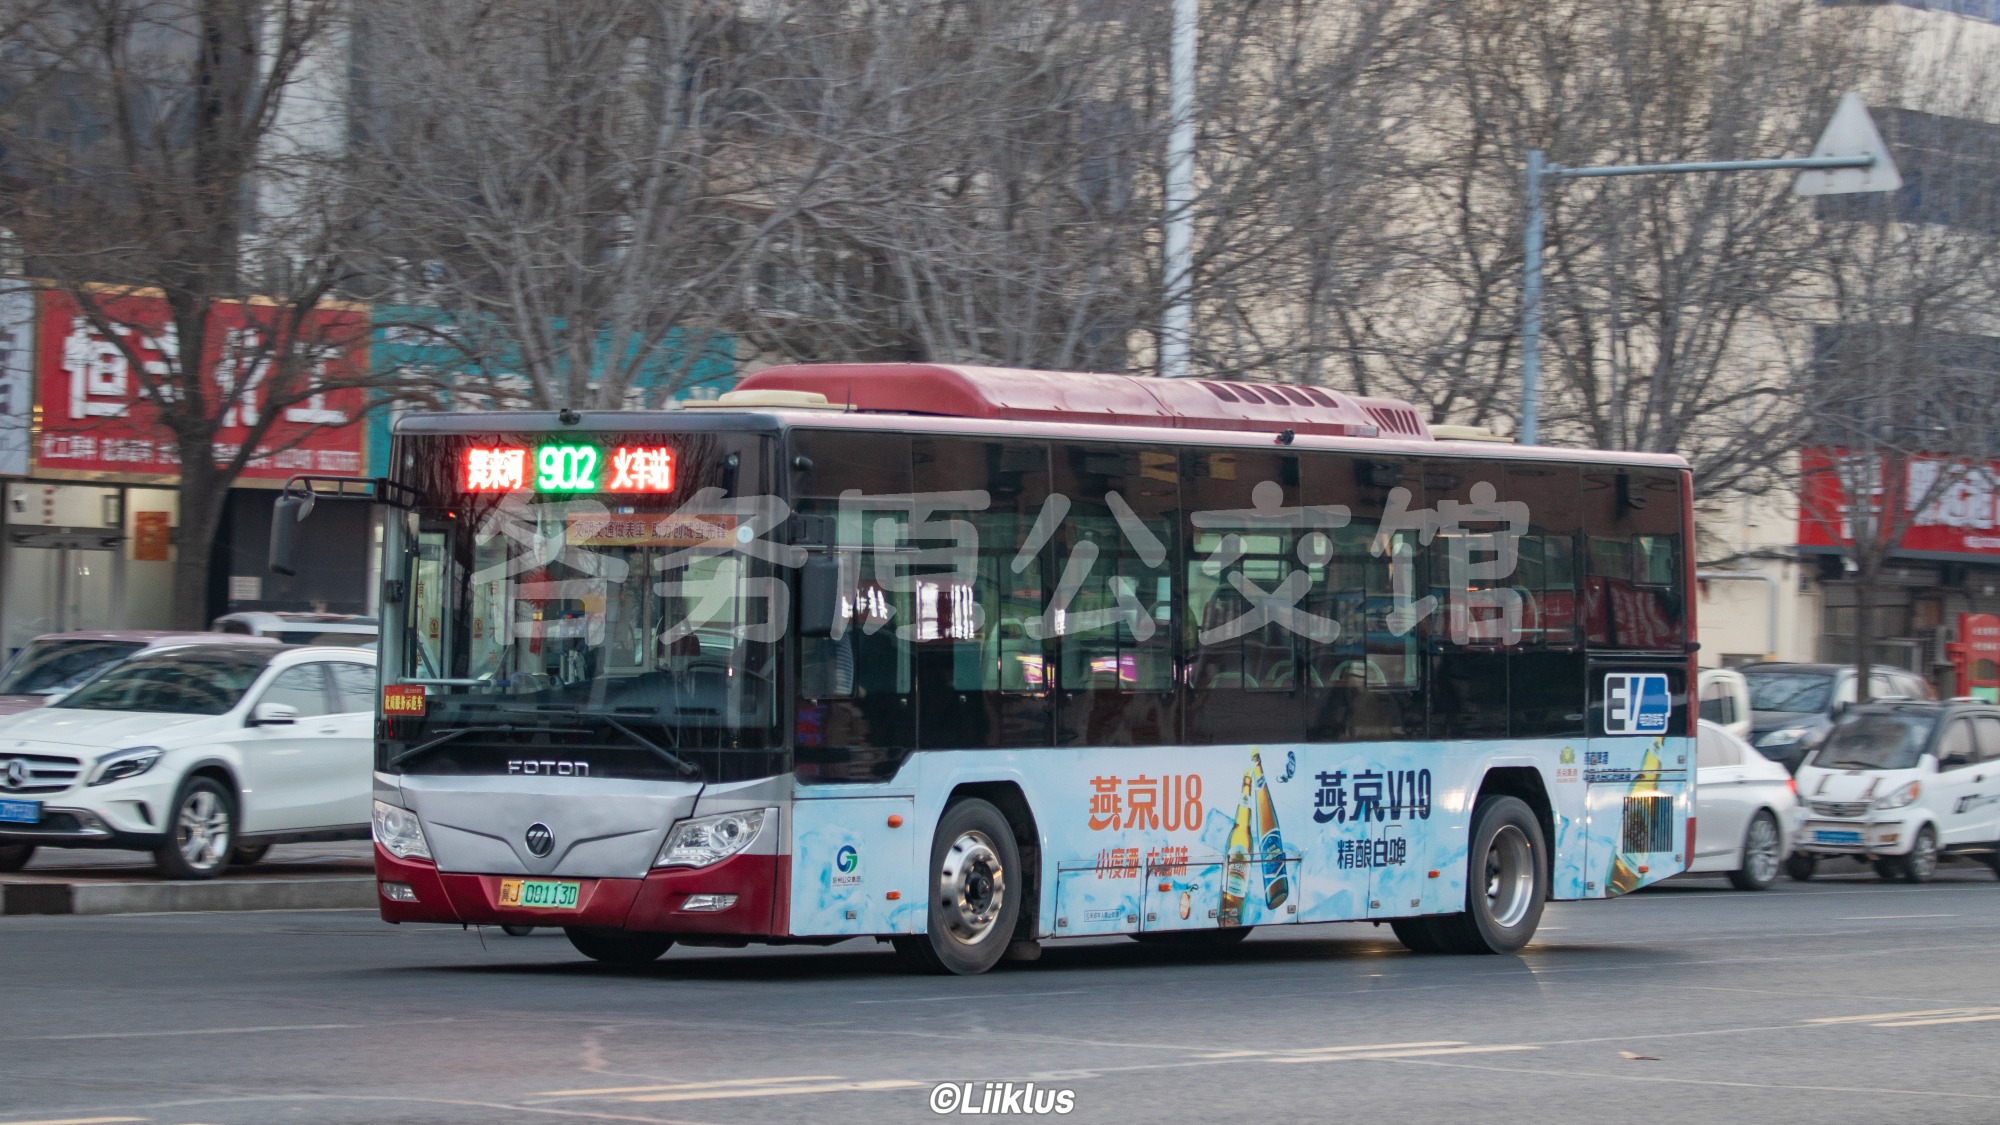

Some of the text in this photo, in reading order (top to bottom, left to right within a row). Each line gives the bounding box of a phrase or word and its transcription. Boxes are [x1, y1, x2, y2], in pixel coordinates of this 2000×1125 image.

[538, 446, 597, 490] 902
[611, 448, 671, 490] 火车站
[574, 521, 727, 540] 文明交通做表率 助力创城当先锋
[508, 760, 589, 777] FOTON
[1088, 774, 1203, 832] 燕京U8
[1313, 768, 1431, 824] 燕京V10
[1095, 848, 1140, 880] 小度酒
[1338, 837, 1406, 869] 精酿白啤
